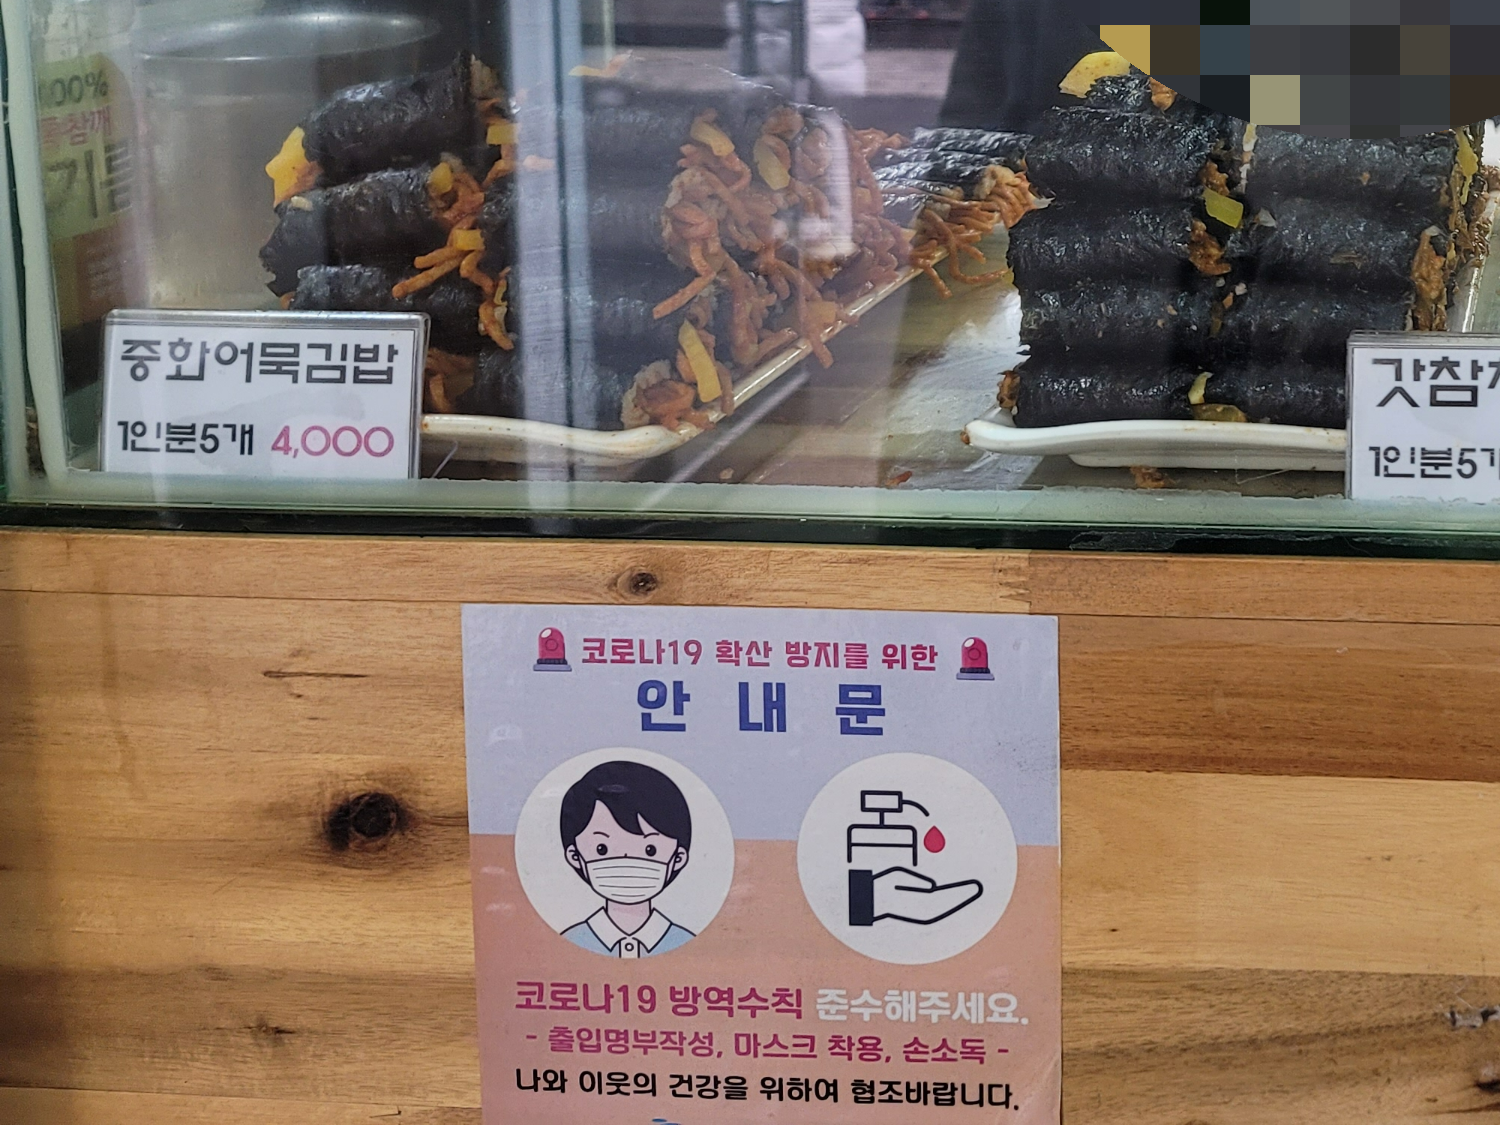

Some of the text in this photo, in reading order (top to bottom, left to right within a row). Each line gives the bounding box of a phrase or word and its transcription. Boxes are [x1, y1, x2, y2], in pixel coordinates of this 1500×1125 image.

[120, 337, 400, 386] 중화어묵김밥
[270, 424, 396, 460] 4,000
[582, 637, 939, 672] 코로나19 확산 방지를 위한
[515, 980, 1030, 1026] 코로나19 방역수칙 준수해주세요.
[548, 1025, 723, 1059] 출입명부작성,
[734, 1031, 819, 1060] 마스크
[827, 1034, 892, 1064] 착용,
[902, 1035, 987, 1065] 손소독
[515, 1067, 1020, 1112] 나와 이웃의 건강을 위하여 협조바랍니다.
